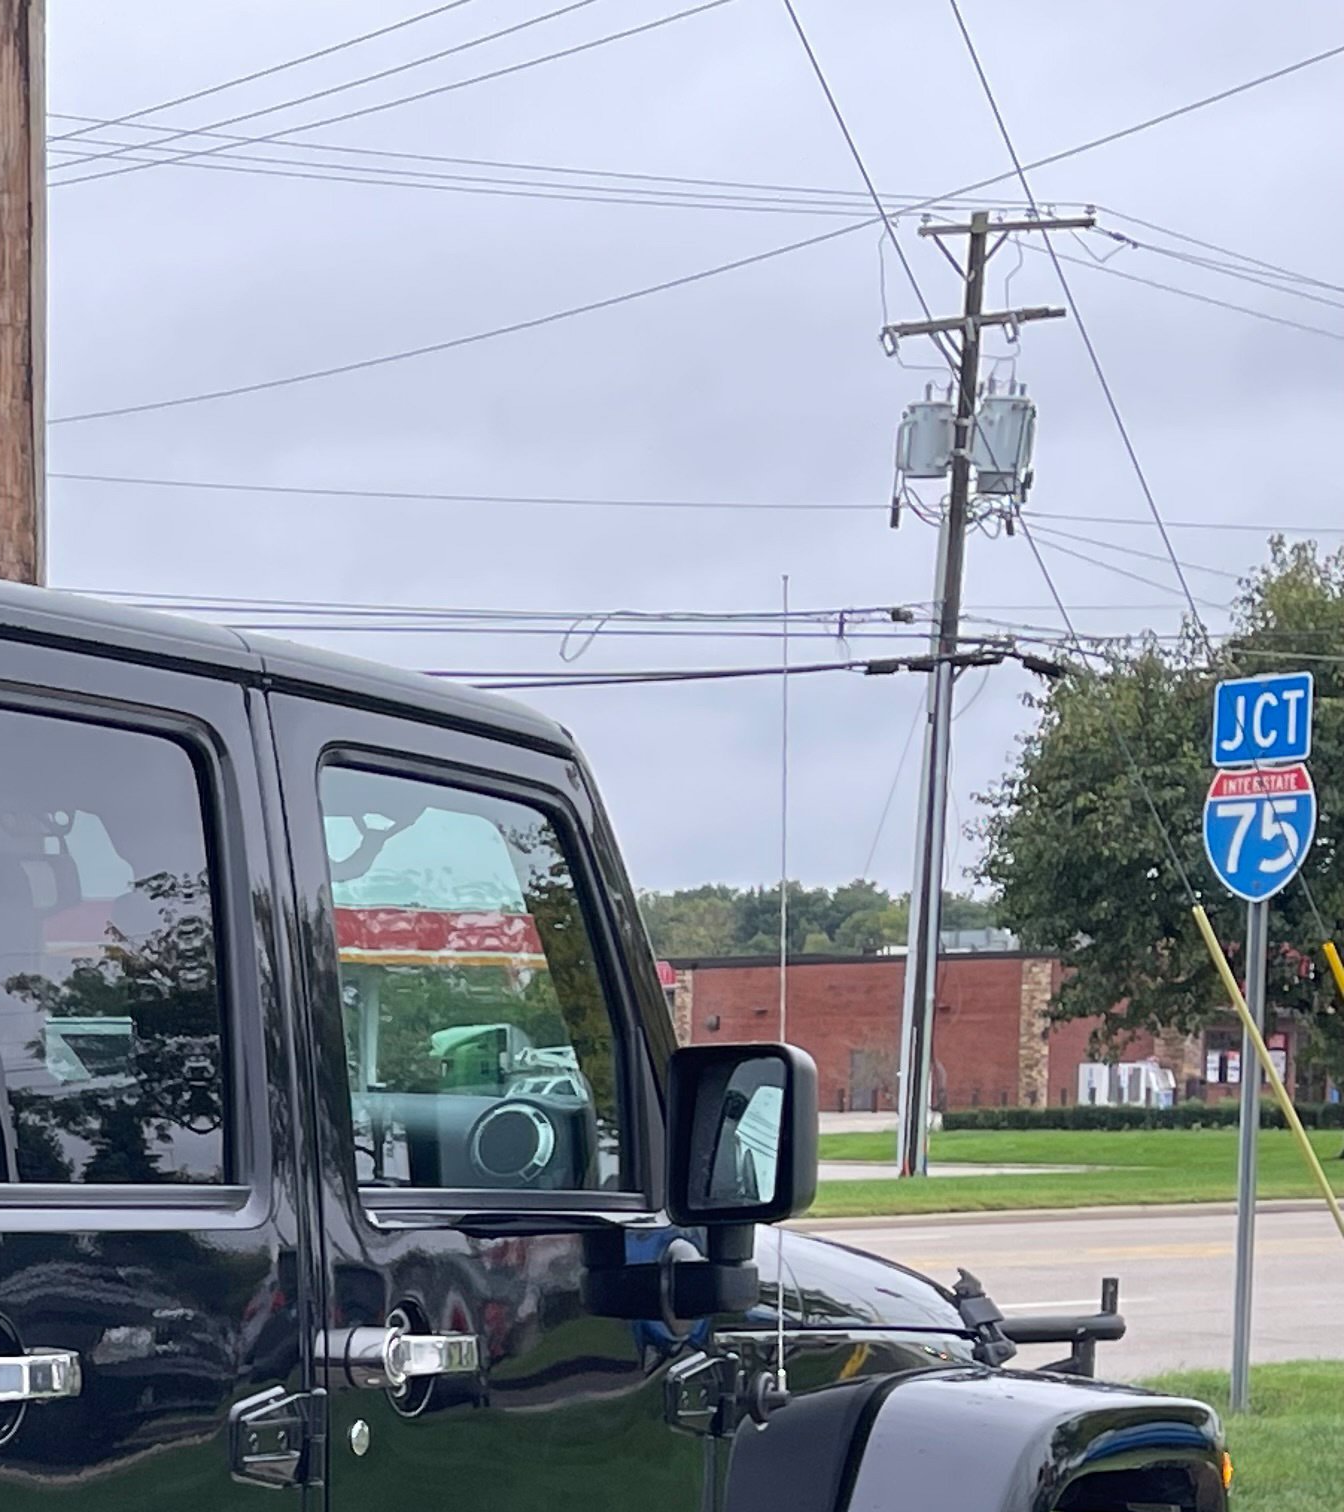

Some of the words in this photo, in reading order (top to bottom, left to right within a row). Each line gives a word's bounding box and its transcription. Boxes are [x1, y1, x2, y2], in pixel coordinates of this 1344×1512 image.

[1220, 689, 1305, 751] JCT
[1223, 773, 1298, 796] INTERSTATE
[1216, 799, 1299, 875] 75
